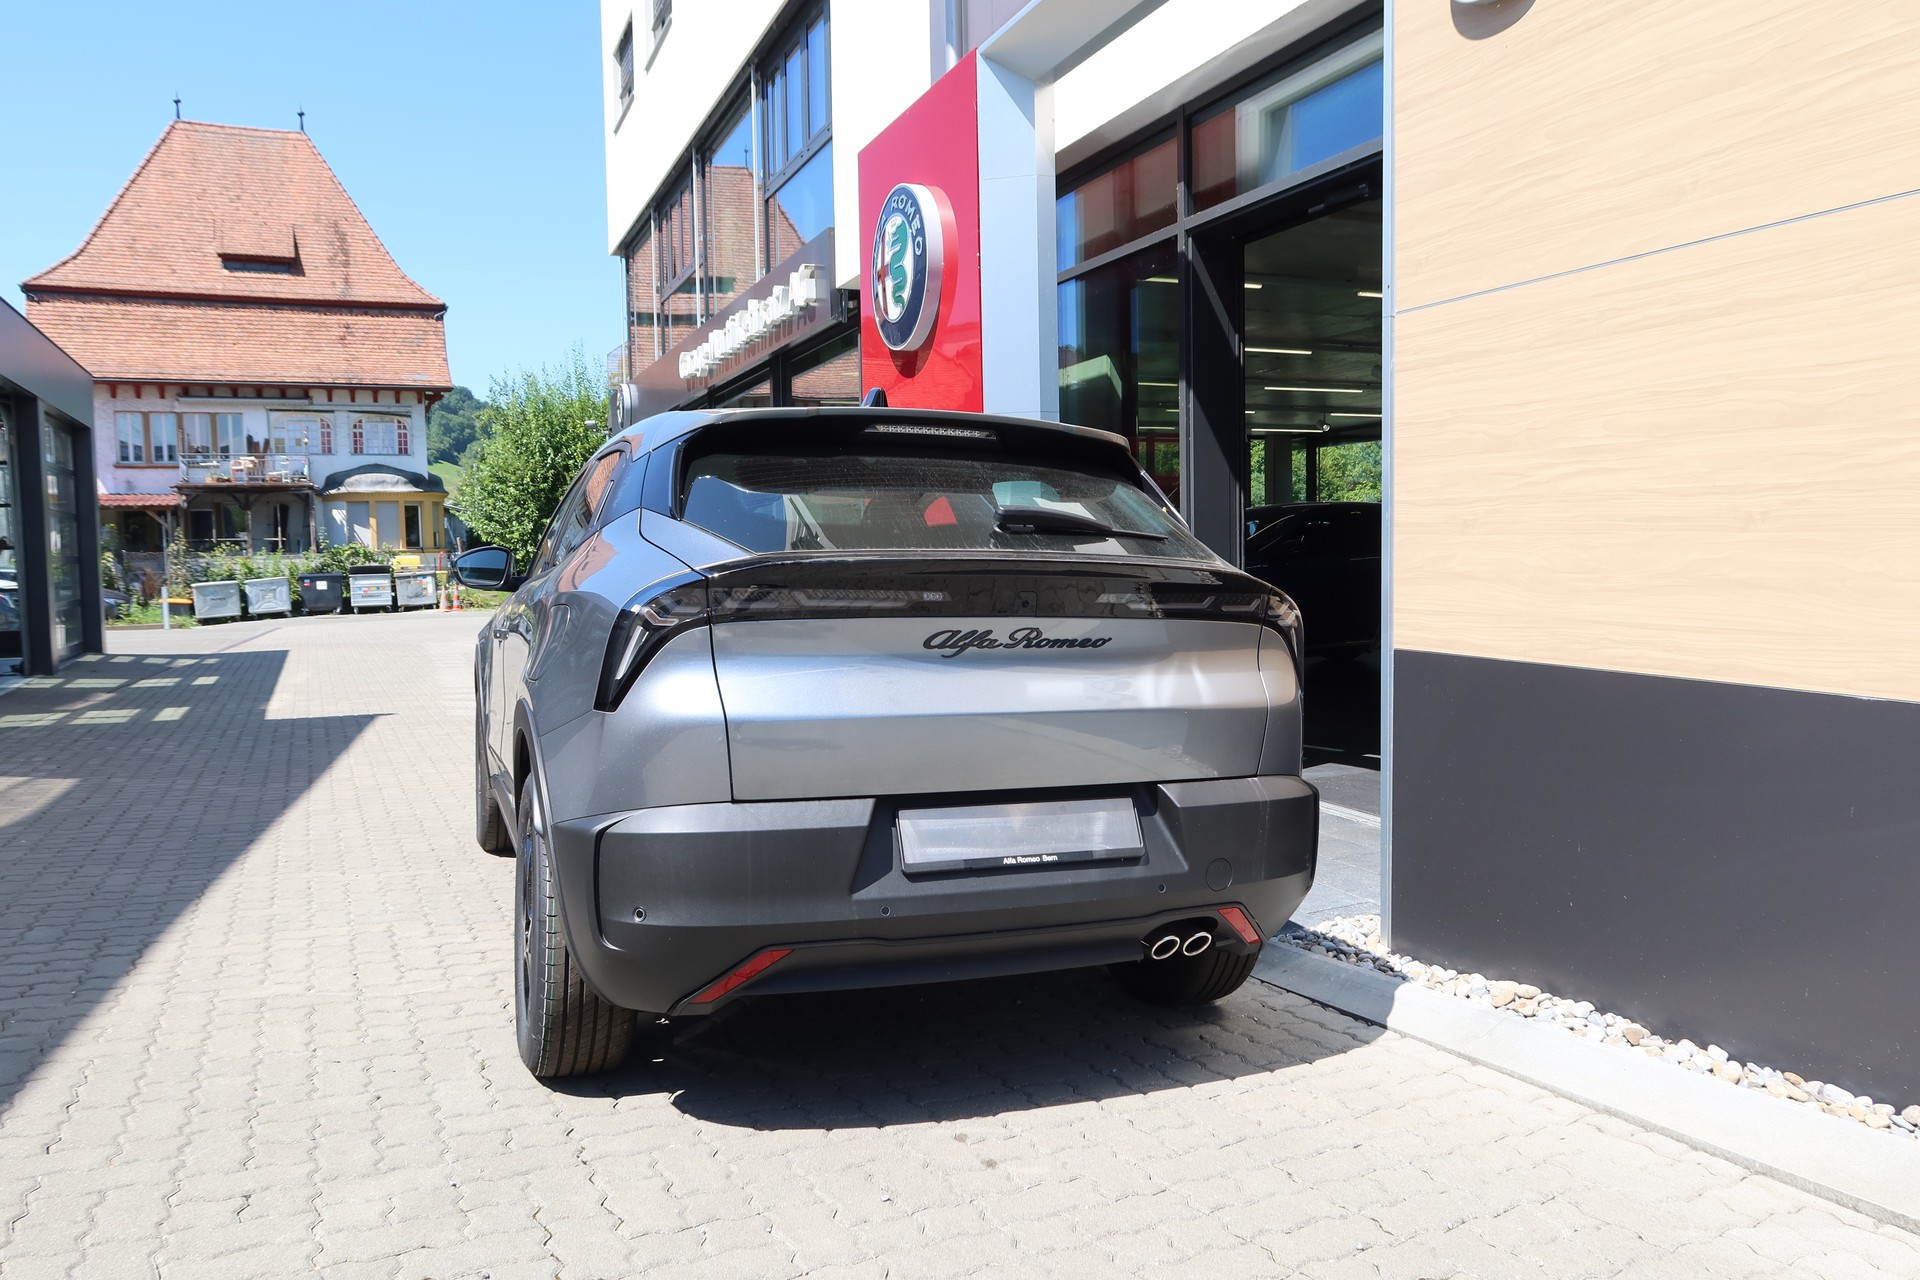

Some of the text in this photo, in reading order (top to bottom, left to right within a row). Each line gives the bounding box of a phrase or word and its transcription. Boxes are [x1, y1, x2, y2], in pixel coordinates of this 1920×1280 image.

[890, 194, 923, 256] ROMEO
[922, 627, 1112, 658] Alfa Romeo
